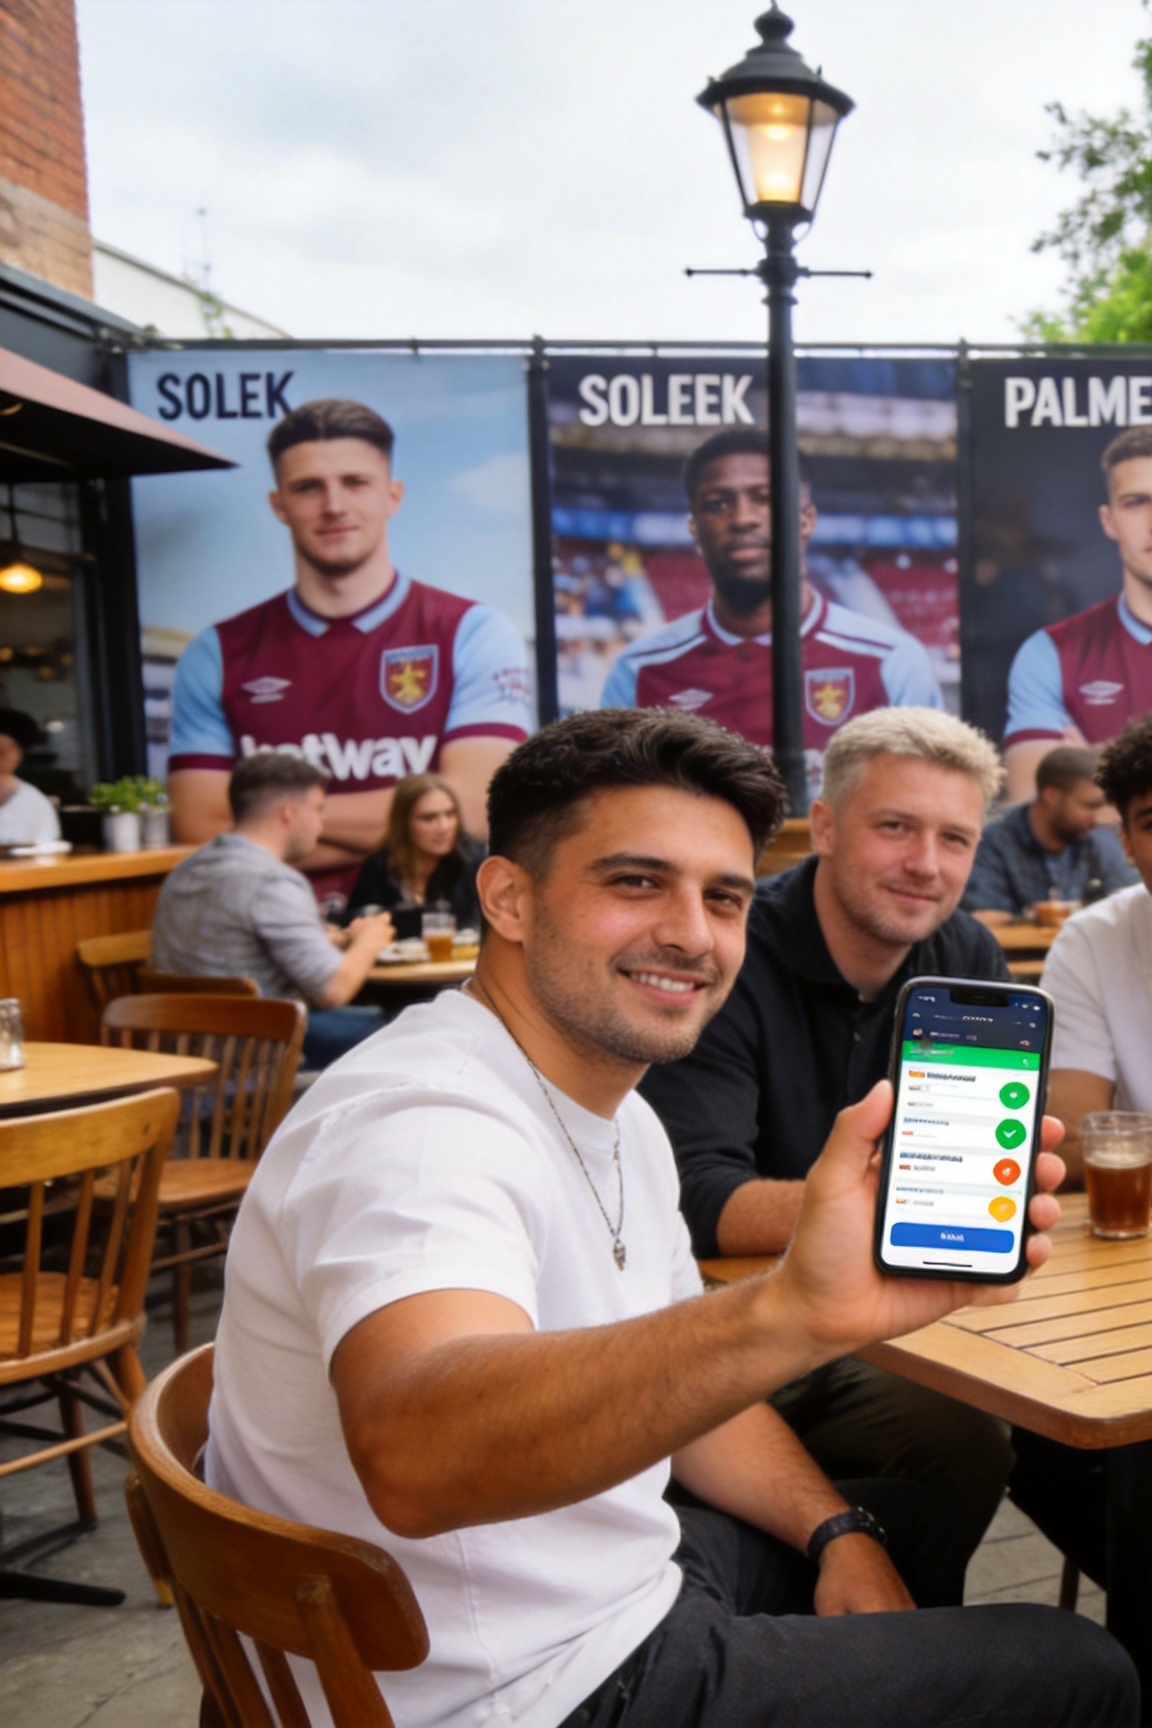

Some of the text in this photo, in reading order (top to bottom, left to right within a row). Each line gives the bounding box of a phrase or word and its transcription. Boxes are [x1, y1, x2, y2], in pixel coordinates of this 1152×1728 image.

[157, 371, 294, 421] SOLEK
[578, 374, 755, 427] SOLEEK
[240, 732, 438, 780] tway
